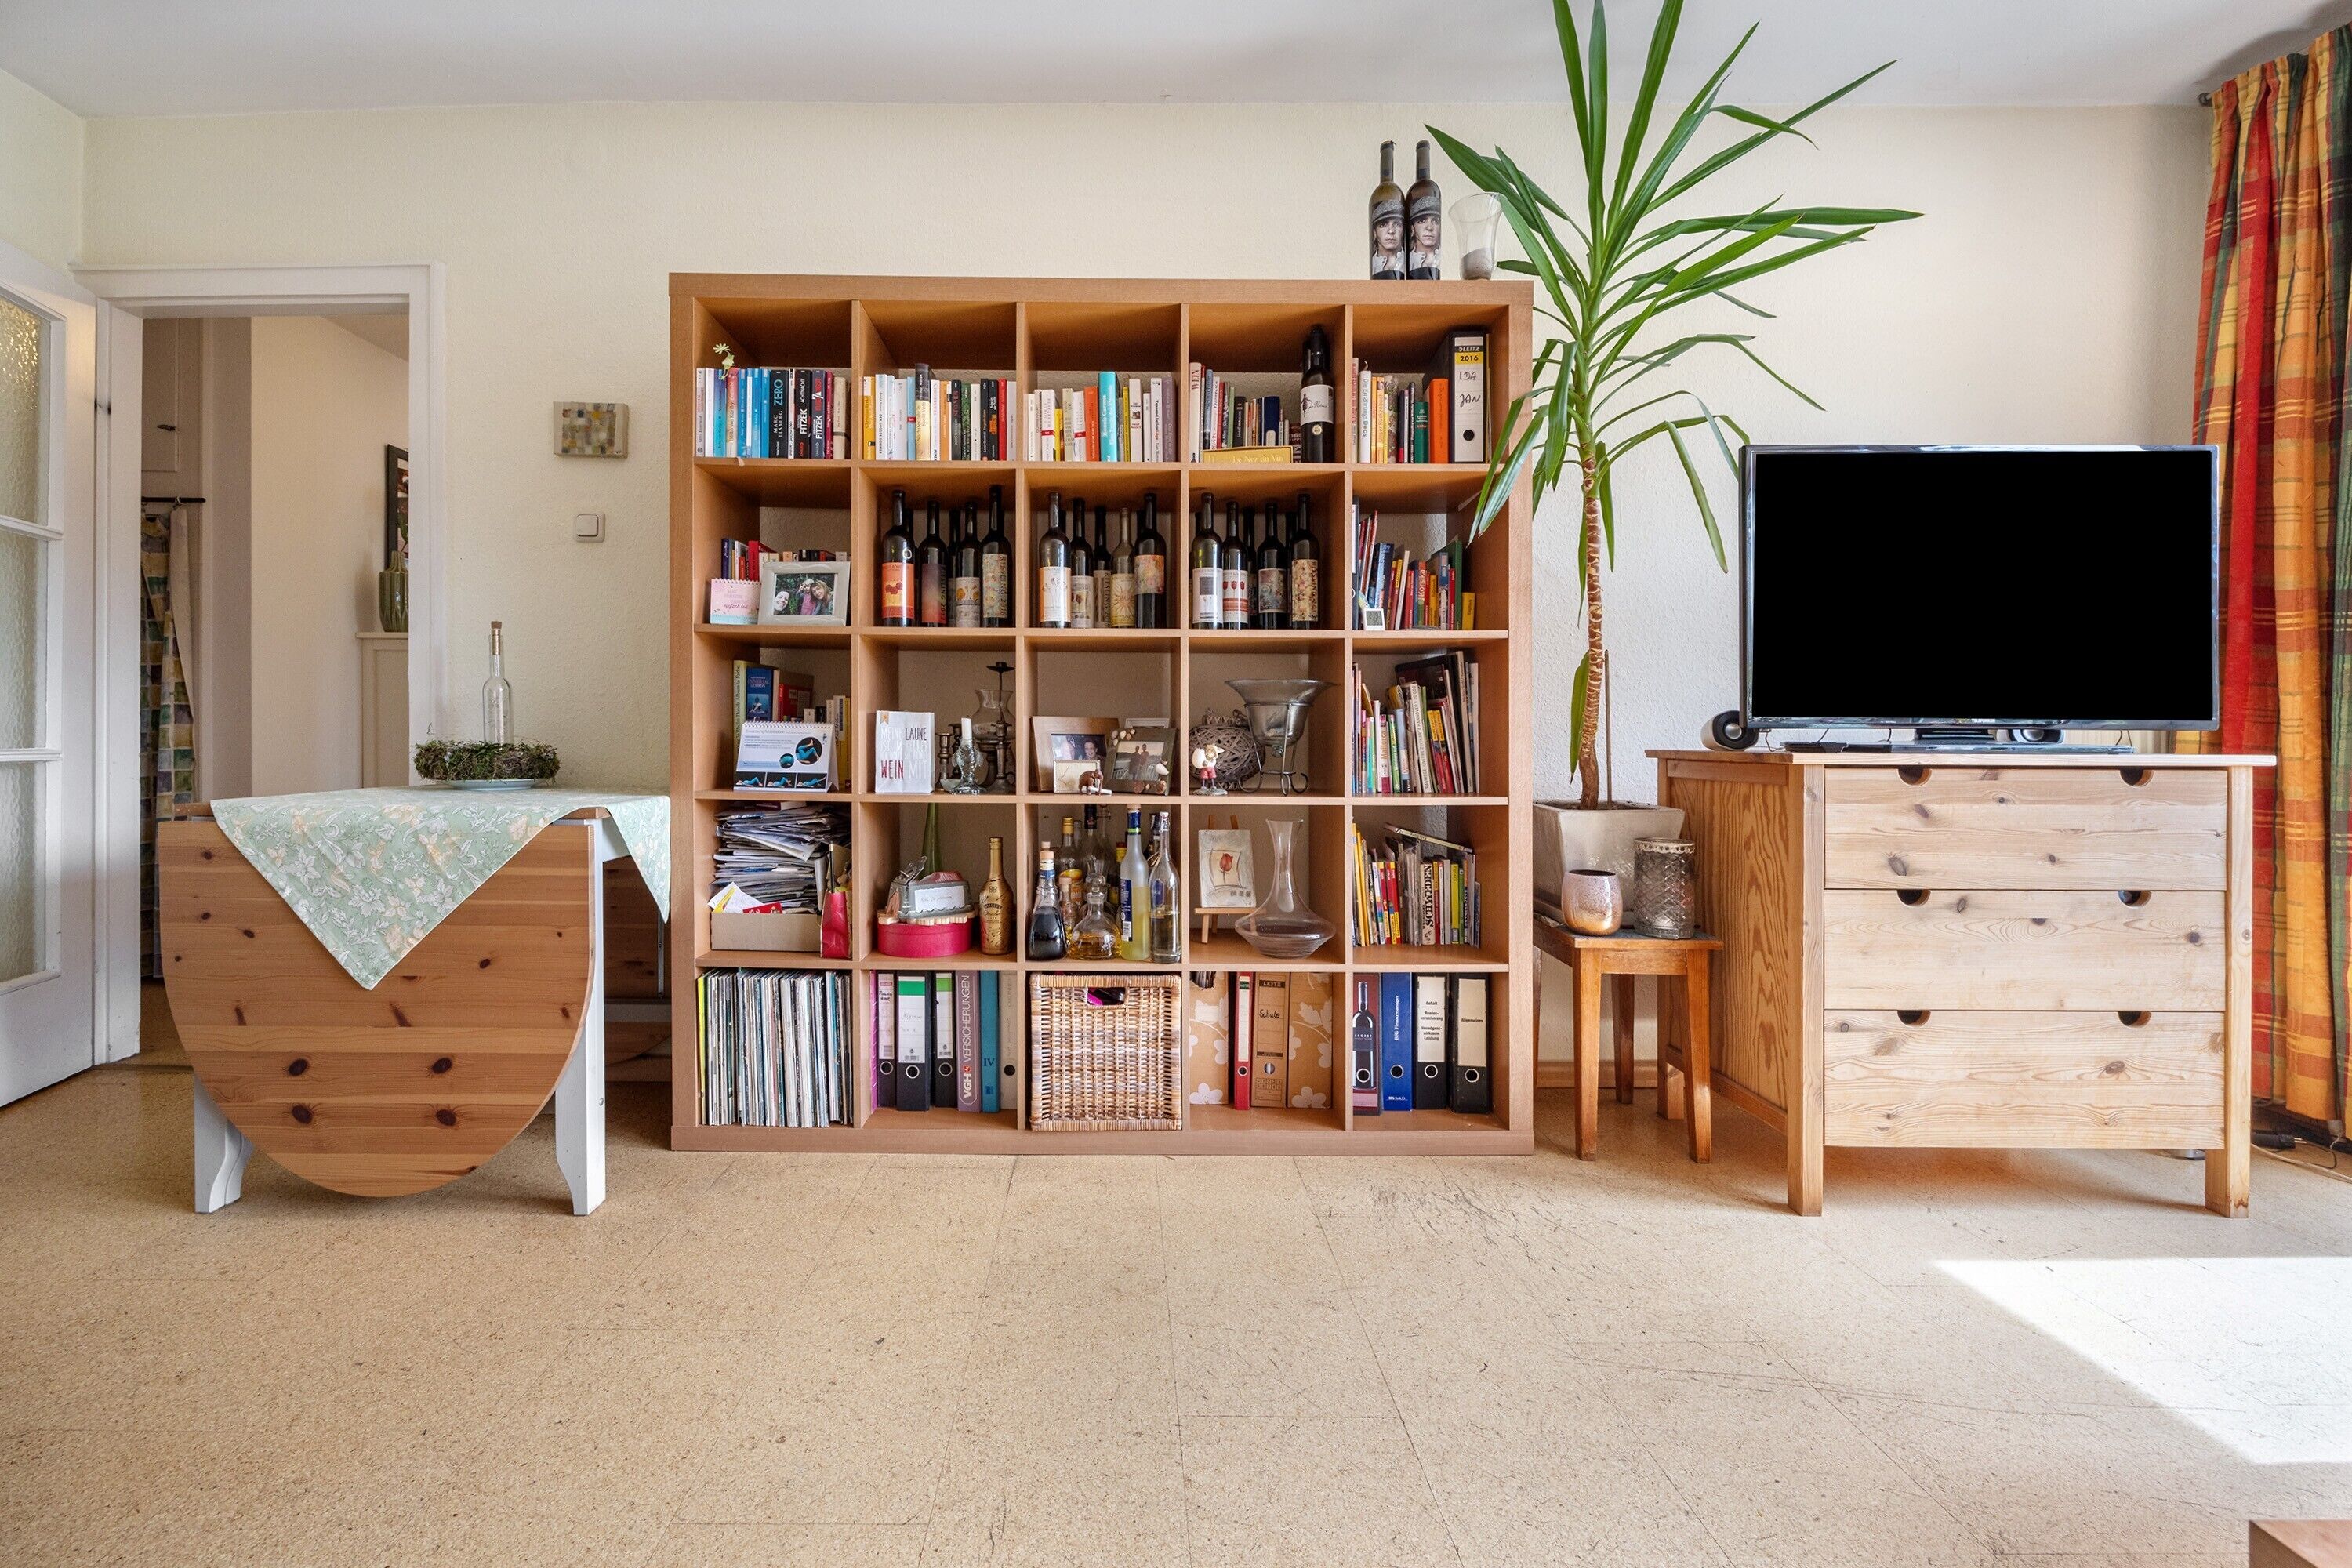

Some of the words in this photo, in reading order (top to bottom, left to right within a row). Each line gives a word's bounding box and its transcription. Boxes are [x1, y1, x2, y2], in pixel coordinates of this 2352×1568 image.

[1191, 369, 1200, 390] WEIN
[1459, 371, 1476, 381] IDA
[773, 379, 783, 406] ZERO
[1459, 394, 1481, 408] JAN
[880, 727, 903, 740] MEINE
[905, 727, 927, 741] LAUNE
[880, 760, 904, 779] WEIN
[909, 760, 927, 779] MIT
[1423, 865, 1434, 927] SCHWEDEN
[961, 975, 971, 1063] VERSICHERUNGEN
[1259, 1009, 1280, 1018] Schule
[964, 1073, 972, 1099] VGH
